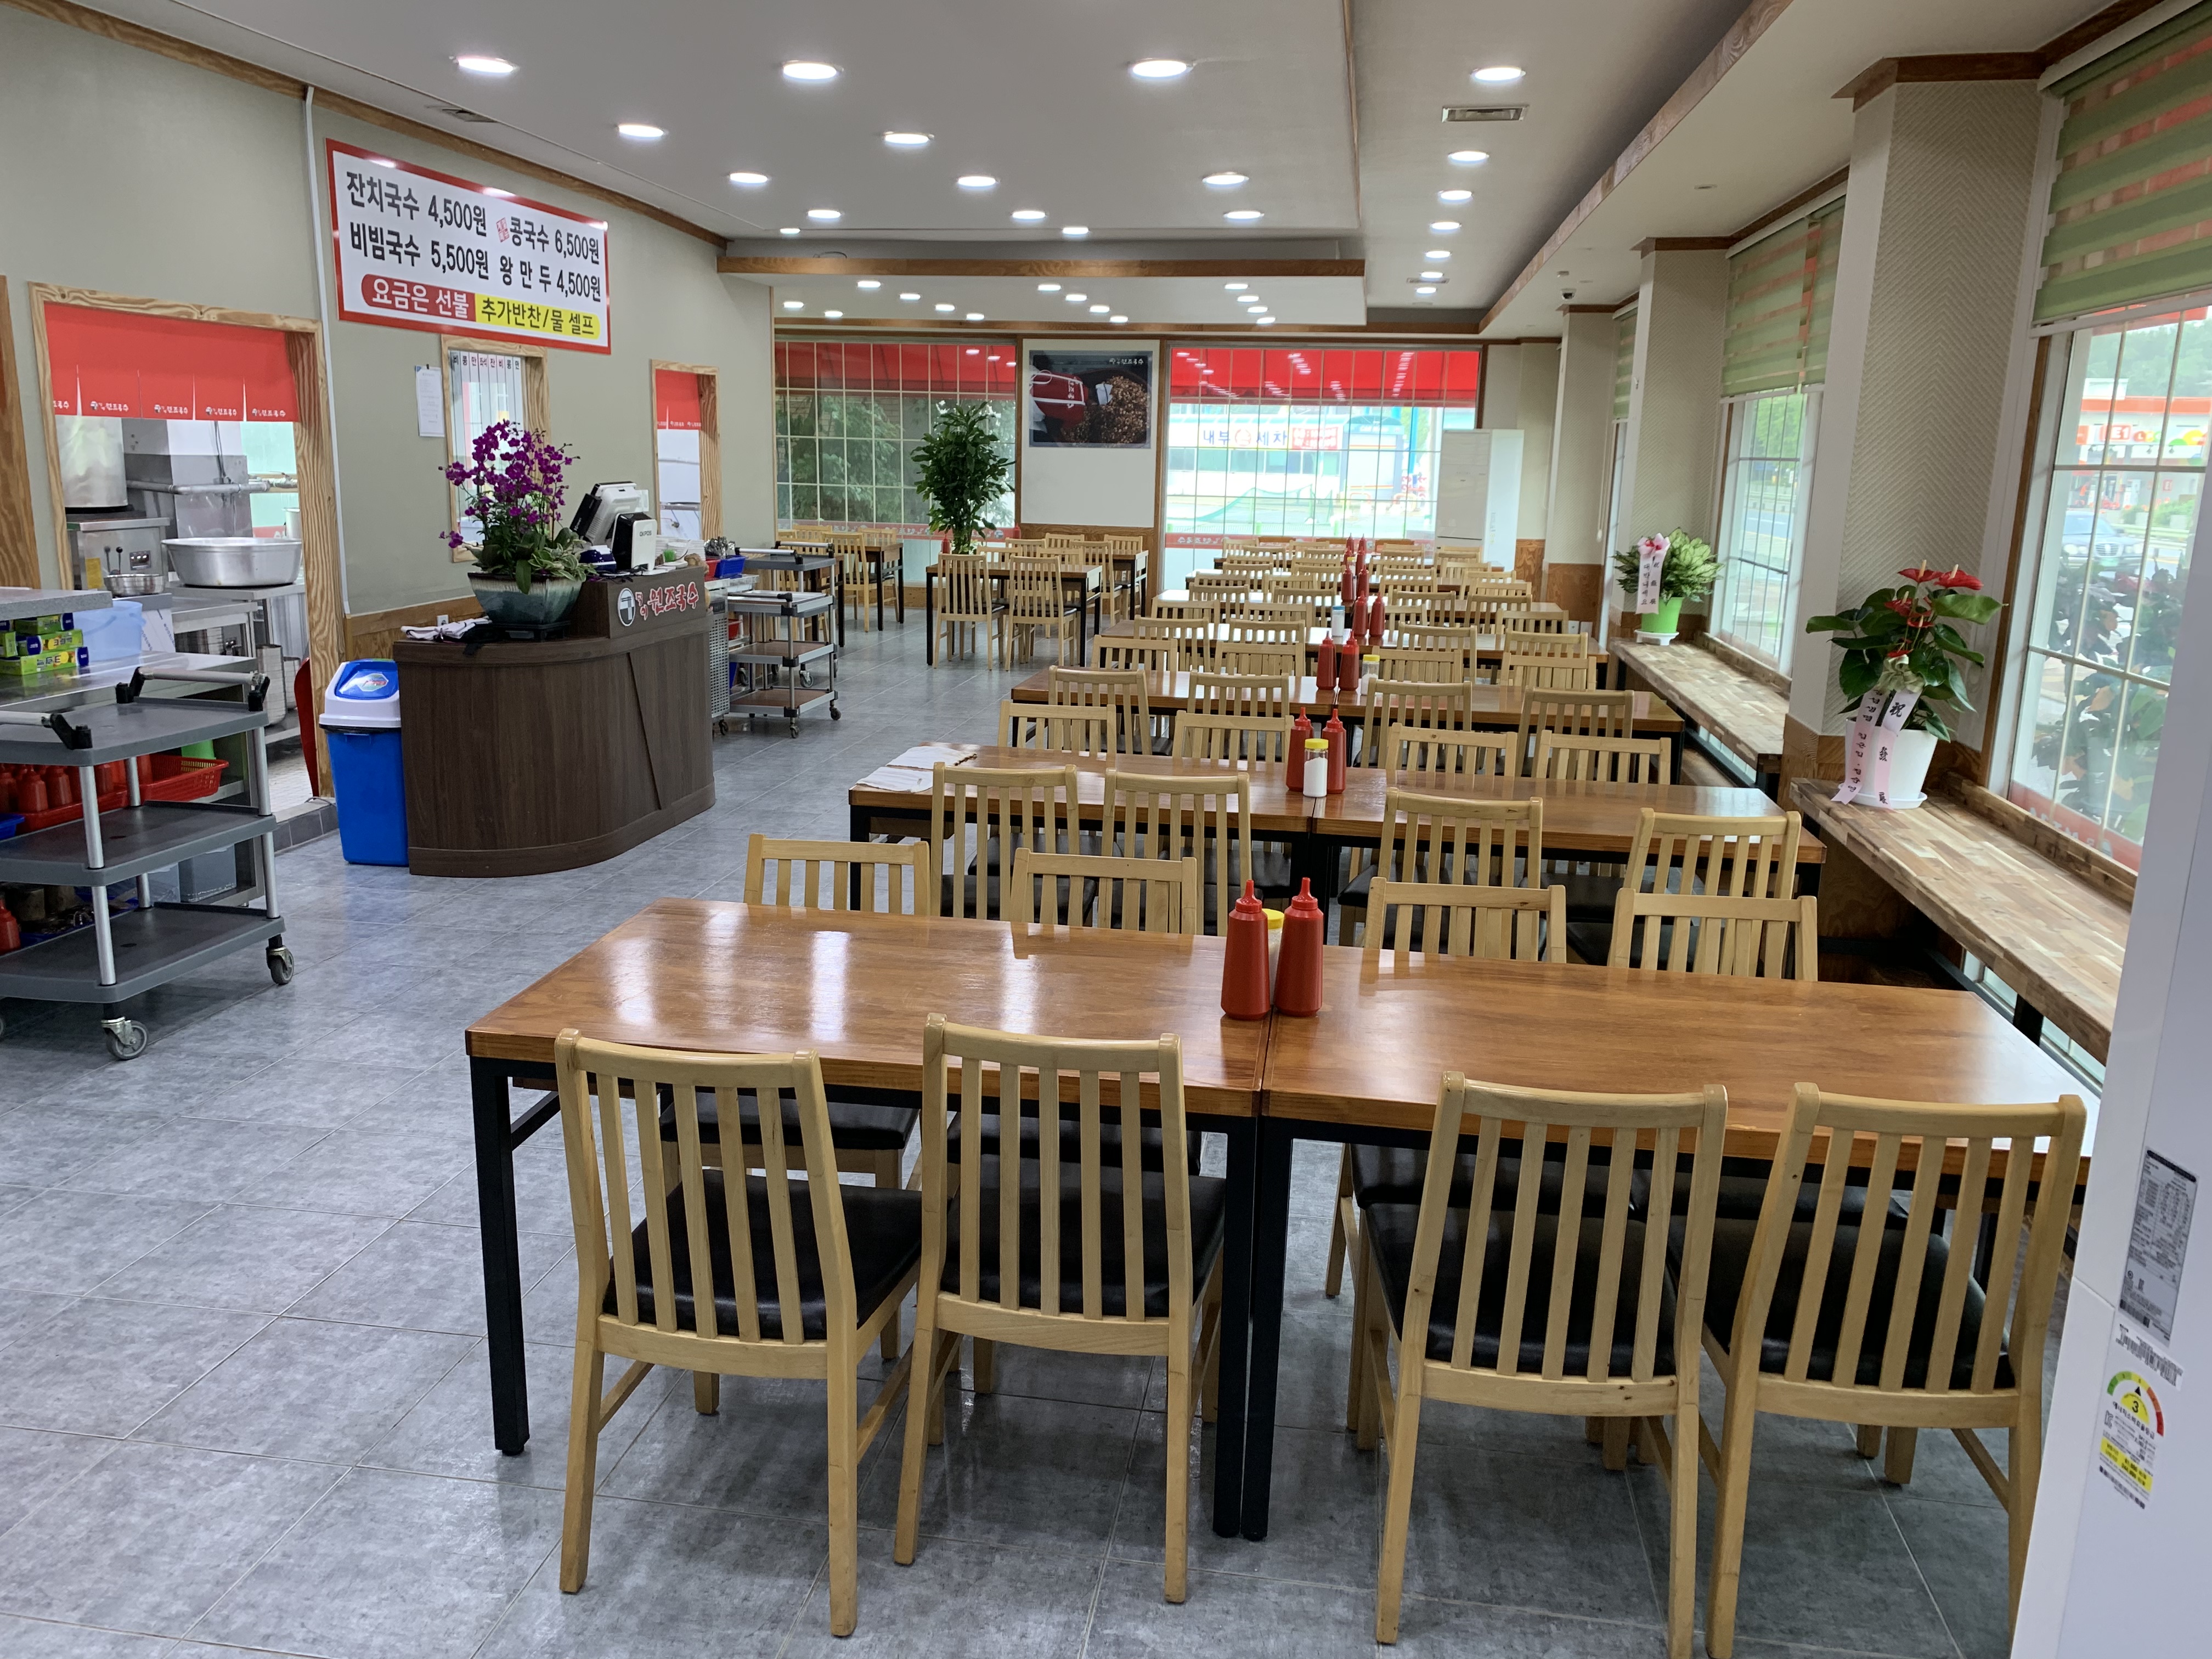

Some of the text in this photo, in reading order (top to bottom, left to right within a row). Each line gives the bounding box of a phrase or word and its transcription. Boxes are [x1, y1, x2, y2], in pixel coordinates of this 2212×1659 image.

[346, 171, 487, 237] 잔치국수 4,500원
[349, 221, 489, 280] 비빔국수 5,500원
[510, 216, 599, 265] 콩국수 6,500원
[500, 255, 601, 302] 왕 만 두 4,500원
[372, 279, 469, 319] 요금은 선불
[482, 298, 594, 336] 추가반찬/물 셀프
[1203, 430, 1231, 445] 내부
[1256, 430, 1288, 446] 세차
[647, 582, 699, 616] 원조국수
[2132, 1401, 2139, 1413] 3
